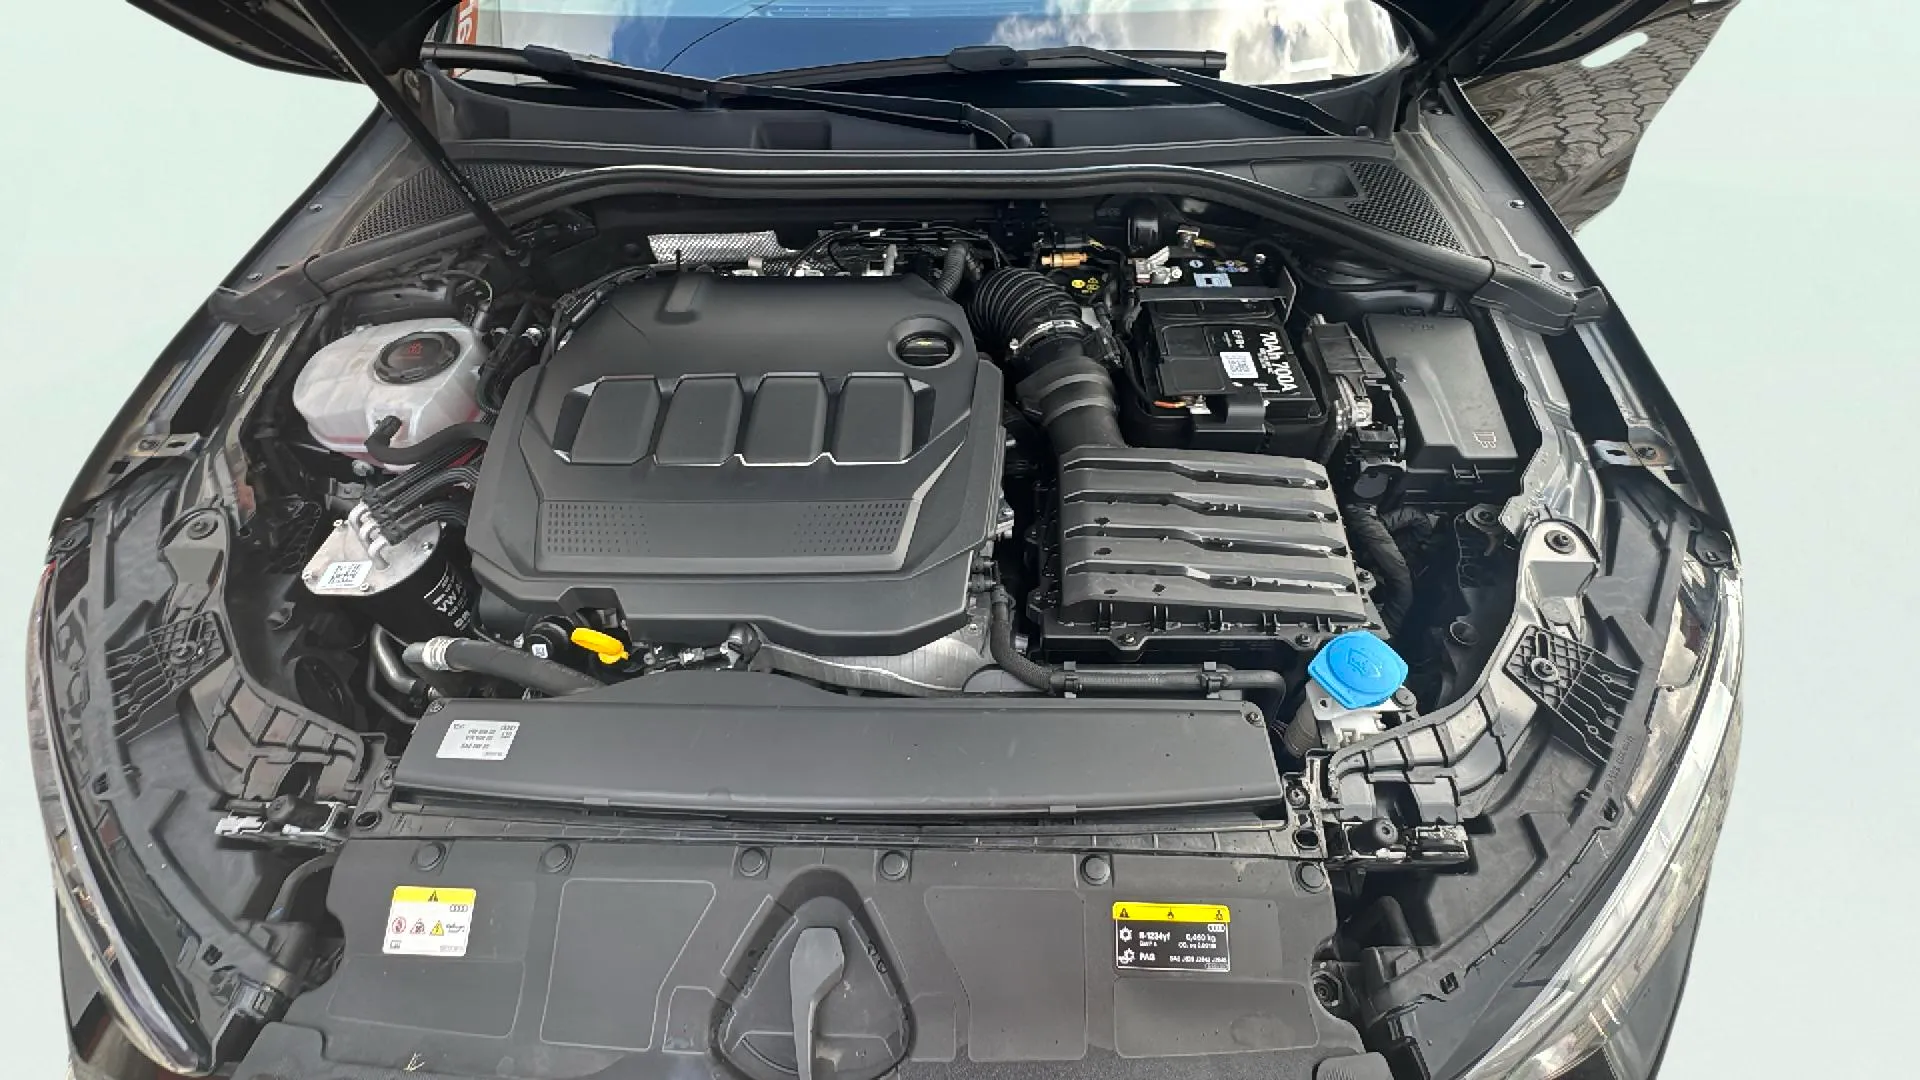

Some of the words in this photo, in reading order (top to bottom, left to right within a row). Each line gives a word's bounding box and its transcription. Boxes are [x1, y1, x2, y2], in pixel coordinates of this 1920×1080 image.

[1260, 332, 1284, 360] 70Ah
[1272, 362, 1298, 392] 700A
[1139, 952, 1156, 961] PAG
